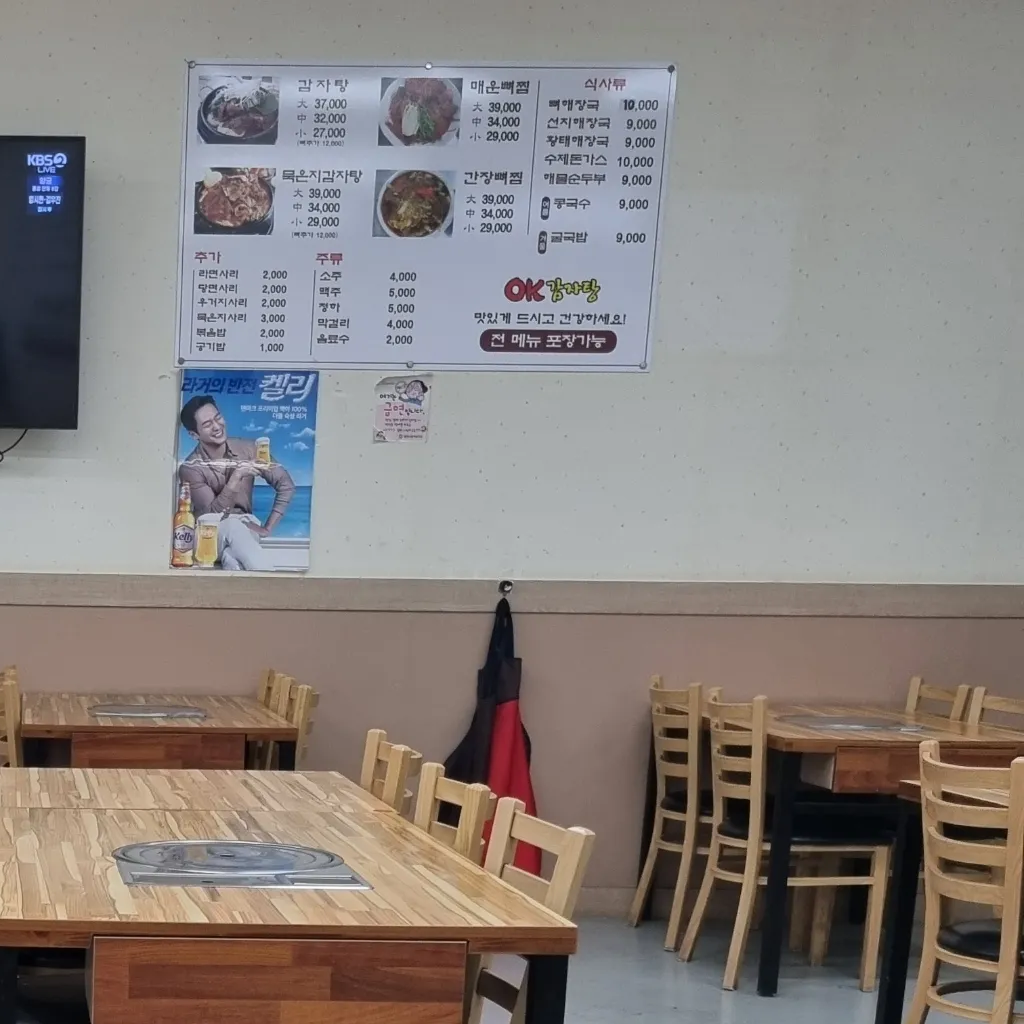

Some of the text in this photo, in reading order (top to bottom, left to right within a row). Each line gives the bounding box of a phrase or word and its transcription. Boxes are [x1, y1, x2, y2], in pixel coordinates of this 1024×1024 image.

[298, 78, 349, 92] 감자탕
[471, 80, 530, 95] 매운뼈찜
[585, 78, 626, 91] 식사류
[297, 99, 347, 111] 大 37,000
[472, 102, 521, 114] 大 39,000
[549, 99, 658, 112] 뼈해장국 10,000
[297, 113, 346, 125] 中 32,000
[472, 117, 520, 128] 中 34,000
[547, 117, 656, 130] 선지해장국 9,000
[295, 128, 345, 139] 小 27,000
[470, 131, 519, 142] 小 29,000
[546, 135, 655, 149] 황태해장국 9,000
[545, 154, 653, 168] 수제돈가스 10,000
[282, 170, 362, 183] 묵은지감자탕
[464, 171, 523, 185] 간장뼈찜
[544, 173, 652, 186] 해물순두부 9,000
[293, 188, 341, 199] 大 39,000
[466, 194, 514, 206] 大 39,000
[554, 198, 648, 210] 콩국수 9,000
[293, 203, 340, 213] 中 34,000
[466, 209, 513, 220] 中 34,000
[291, 217, 339, 228] 小 29,000
[464, 223, 512, 234] 小 29,000
[617, 233, 646, 244] 9,000
[195, 252, 221, 264] 추가
[316, 253, 342, 265] 주류
[199, 270, 287, 280] 라면사리 2,000
[320, 272, 416, 282] 소주 4,000
[198, 284, 287, 294] 당면사리 2,000
[320, 287, 415, 298] 맥주 5,000
[504, 277, 601, 303] OK 감자탕
[198, 298, 286, 308] 우거지사리 2,000
[388, 304, 414, 314] 5,000
[197, 313, 285, 323] 묵은지사리 3,000
[318, 318, 413, 329] 막걸리 4,000
[475, 312, 626, 325] 맛있게 드시고 건강하세요!
[197, 328, 284, 338] 볶음밥 2,000
[317, 334, 412, 345] 음료수 2,000
[490, 333, 607, 348] 전 메뉴 포장가능
[196, 342, 284, 352] 공기밥 1,000
[182, 377, 224, 394] 라거의
[259, 373, 316, 402] 켈리
[174, 532, 193, 543] Kelly
